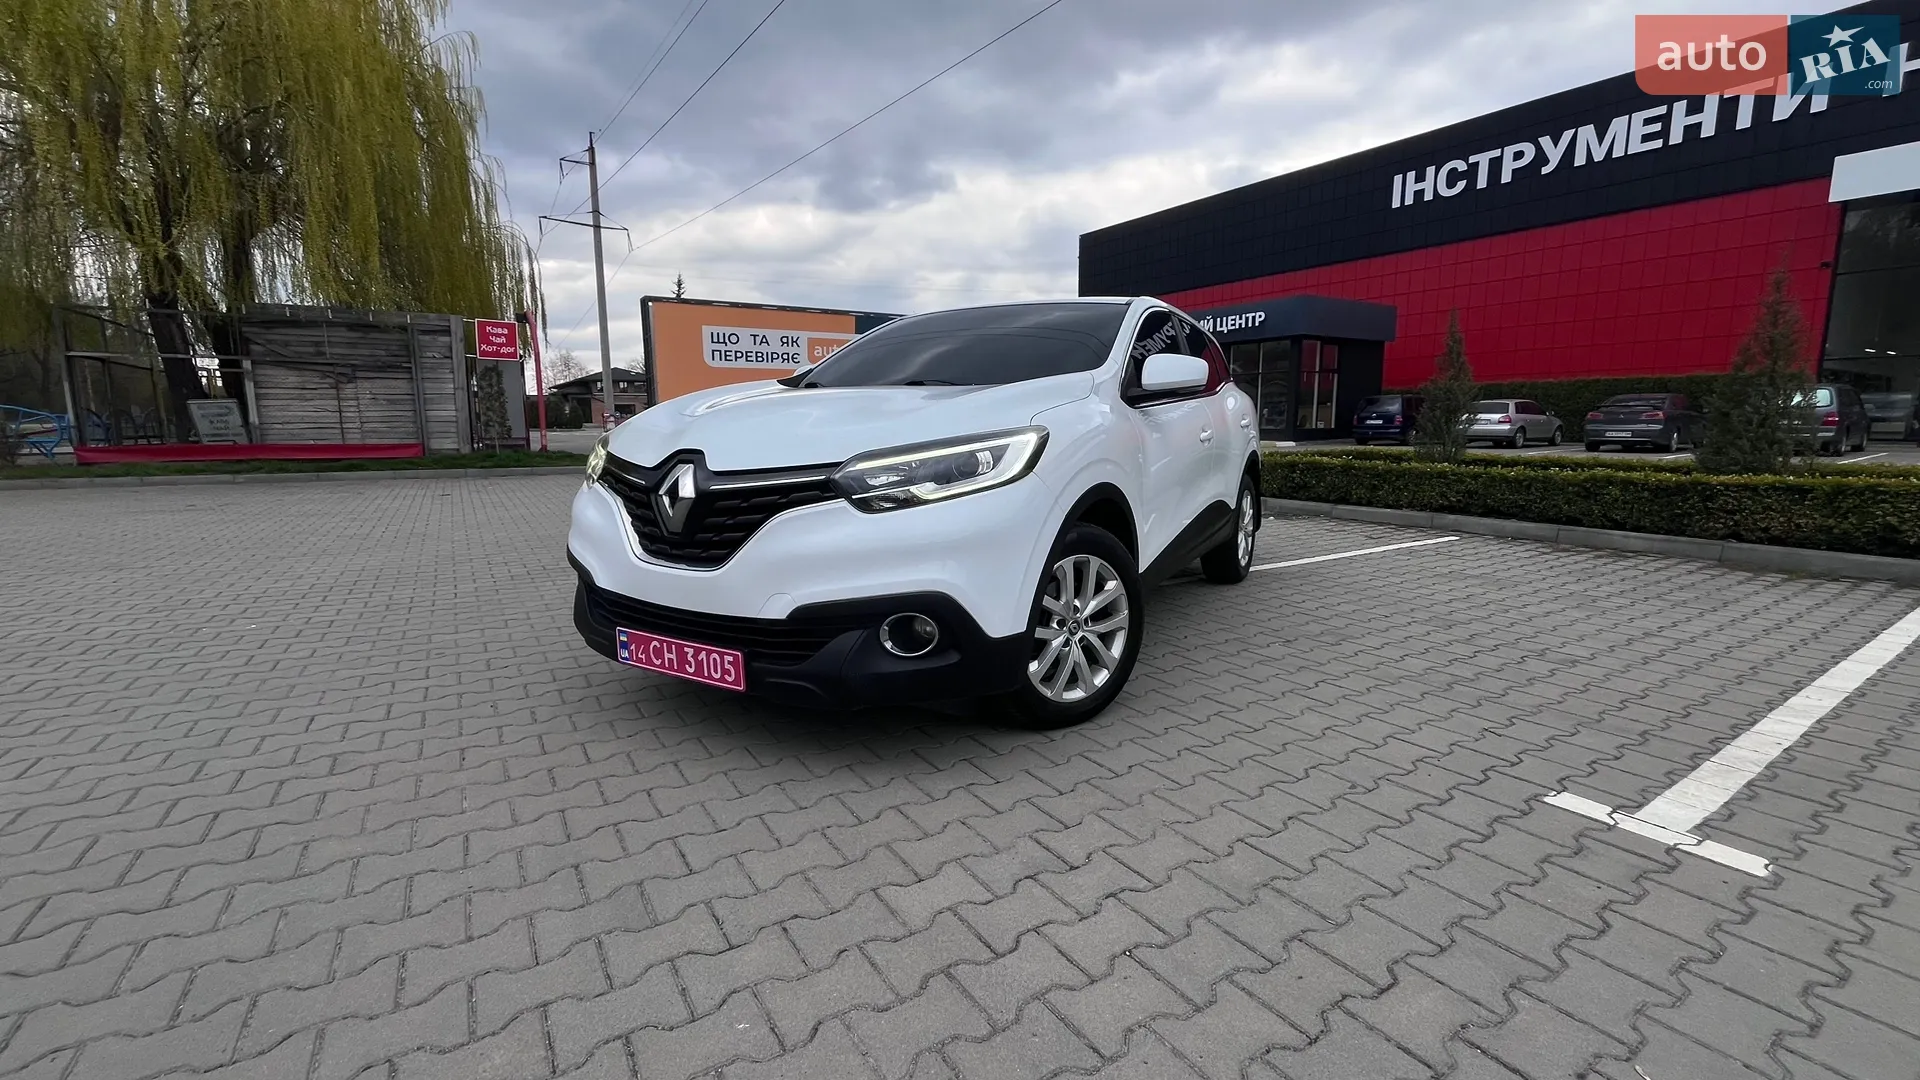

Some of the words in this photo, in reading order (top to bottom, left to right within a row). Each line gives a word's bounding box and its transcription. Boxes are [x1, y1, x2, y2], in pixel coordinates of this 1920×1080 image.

[1392, 71, 1832, 208] ІНСТРУМЕНТИ
[486, 325, 508, 334] Кава
[1216, 311, 1266, 334] ЦЕНТР
[710, 331, 740, 346] ЩО
[750, 334, 770, 347] ТА
[780, 336, 800, 348] ЯК
[480, 343, 515, 353] Хот-дог
[711, 349, 801, 364] ПЕРЕВІРЯЄ
[620, 648, 629, 659] UA
[630, 643, 646, 663] 14
[649, 640, 678, 669] CH
[683, 647, 736, 682] 3105
